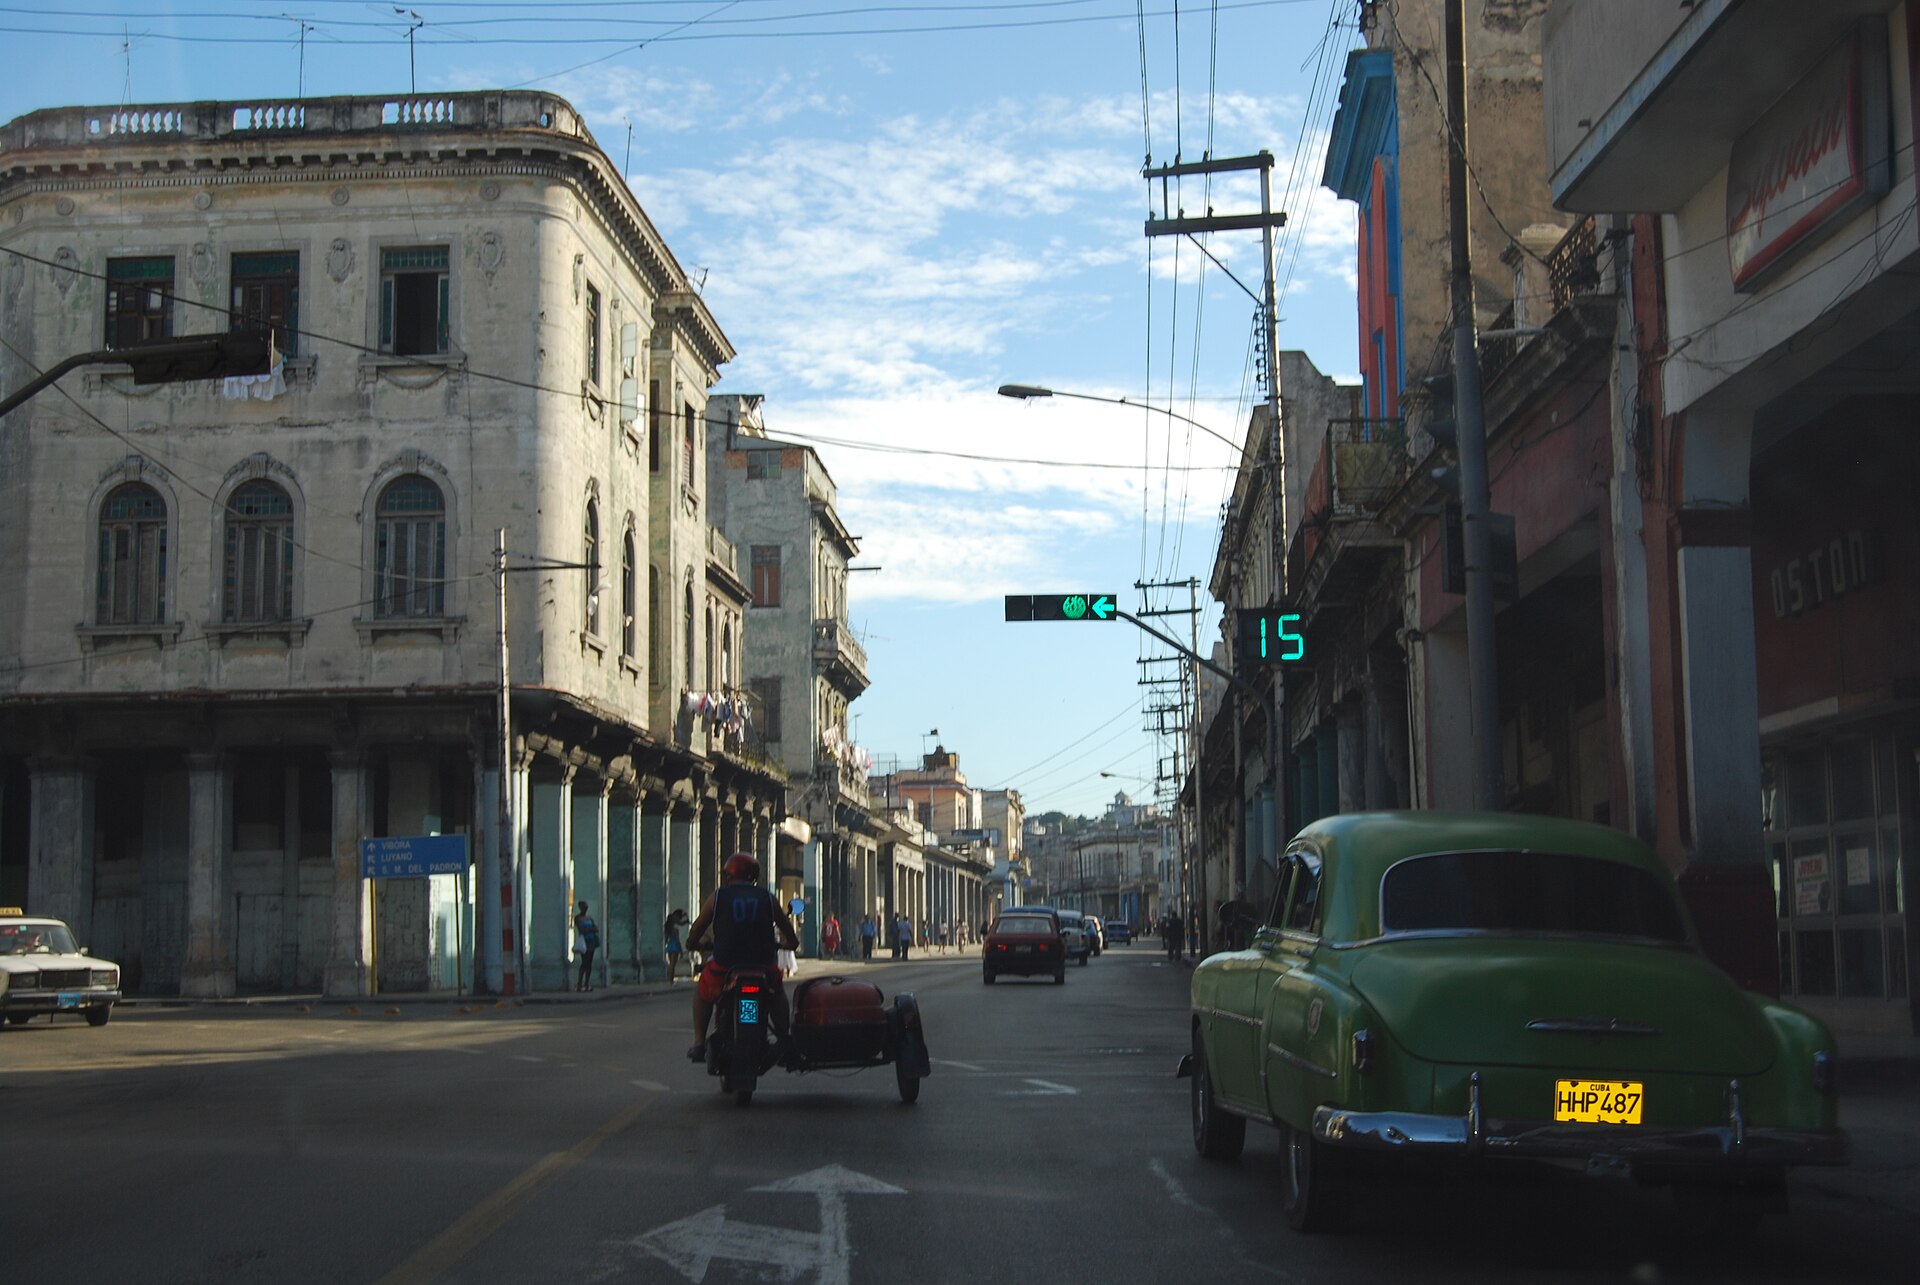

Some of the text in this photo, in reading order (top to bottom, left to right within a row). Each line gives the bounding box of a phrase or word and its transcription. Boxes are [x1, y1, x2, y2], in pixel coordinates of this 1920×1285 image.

[1260, 614, 1304, 661] 15
[381, 840, 412, 849] VIBORA
[408, 864, 423, 873] DEL
[430, 862, 462, 872] PADRON
[733, 898, 758, 922] 07
